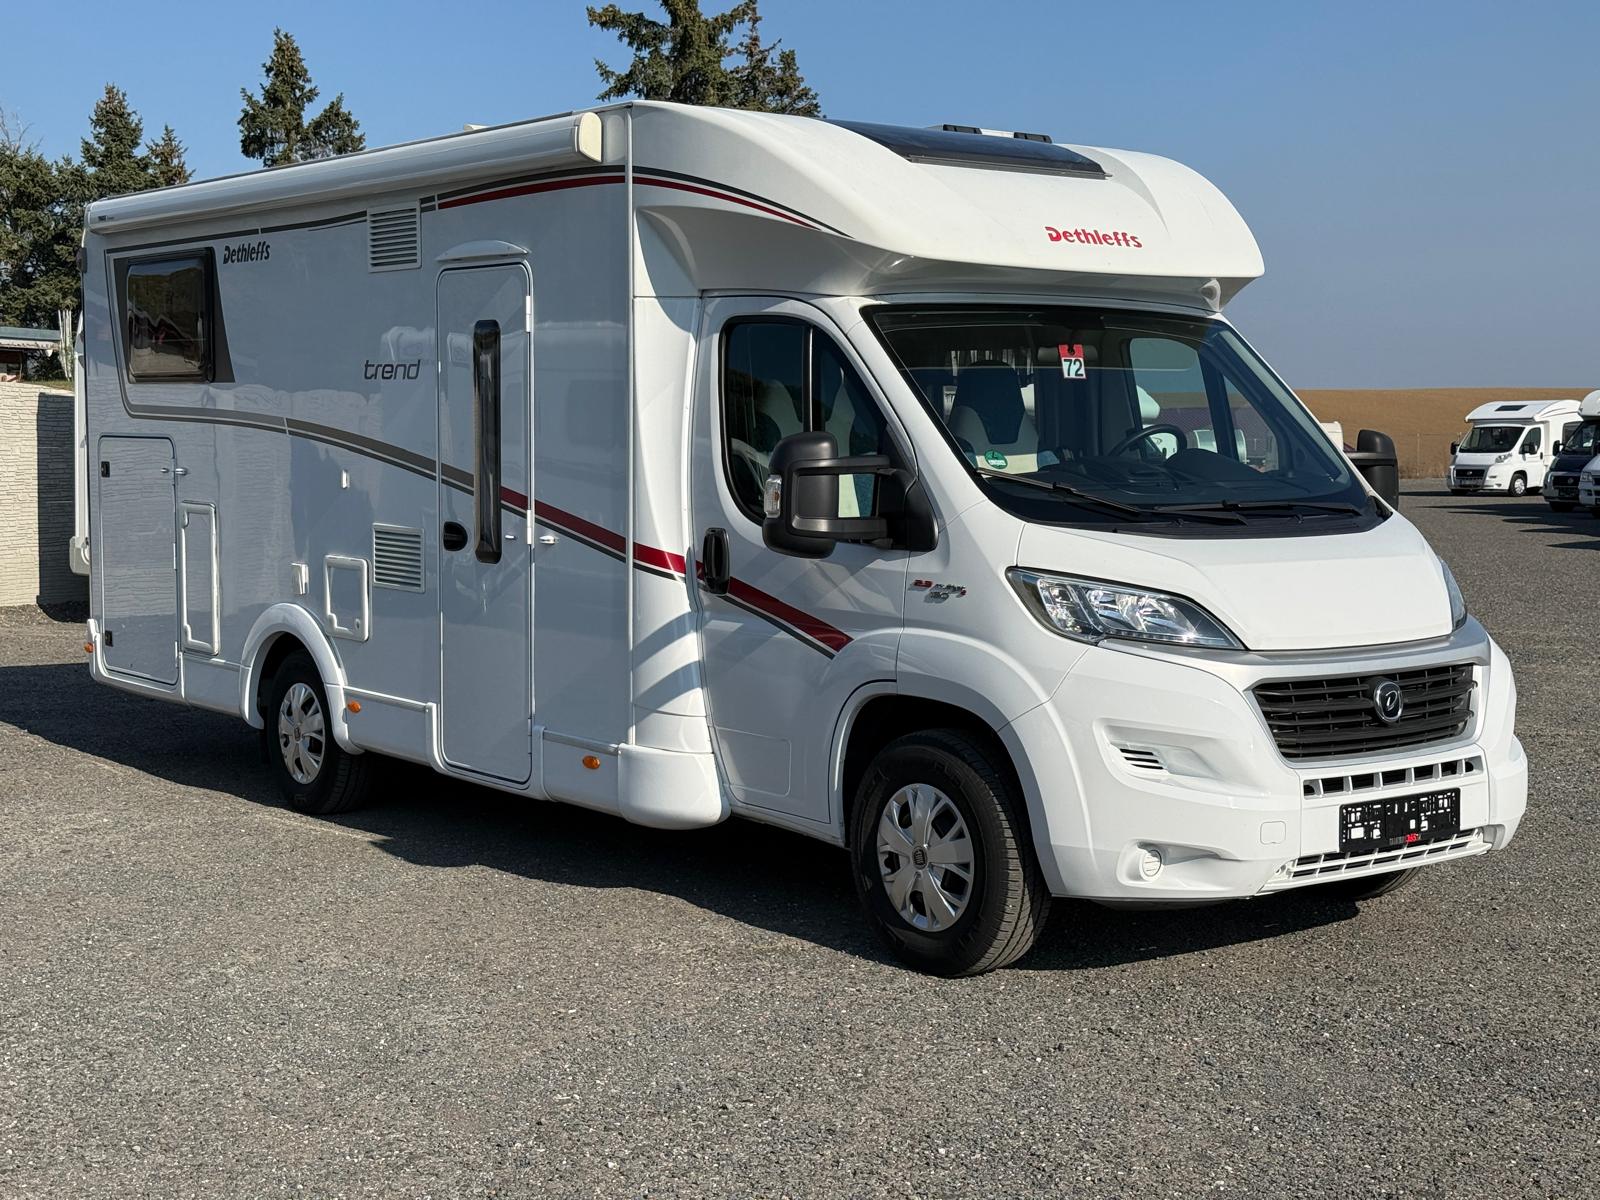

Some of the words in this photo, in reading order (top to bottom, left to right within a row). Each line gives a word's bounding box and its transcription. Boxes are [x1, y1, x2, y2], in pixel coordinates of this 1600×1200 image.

[1044, 226, 1143, 249] Dethleffs
[223, 240, 271, 265] Dethleffs
[364, 359, 421, 380] trend
[1063, 358, 1084, 377] 72
